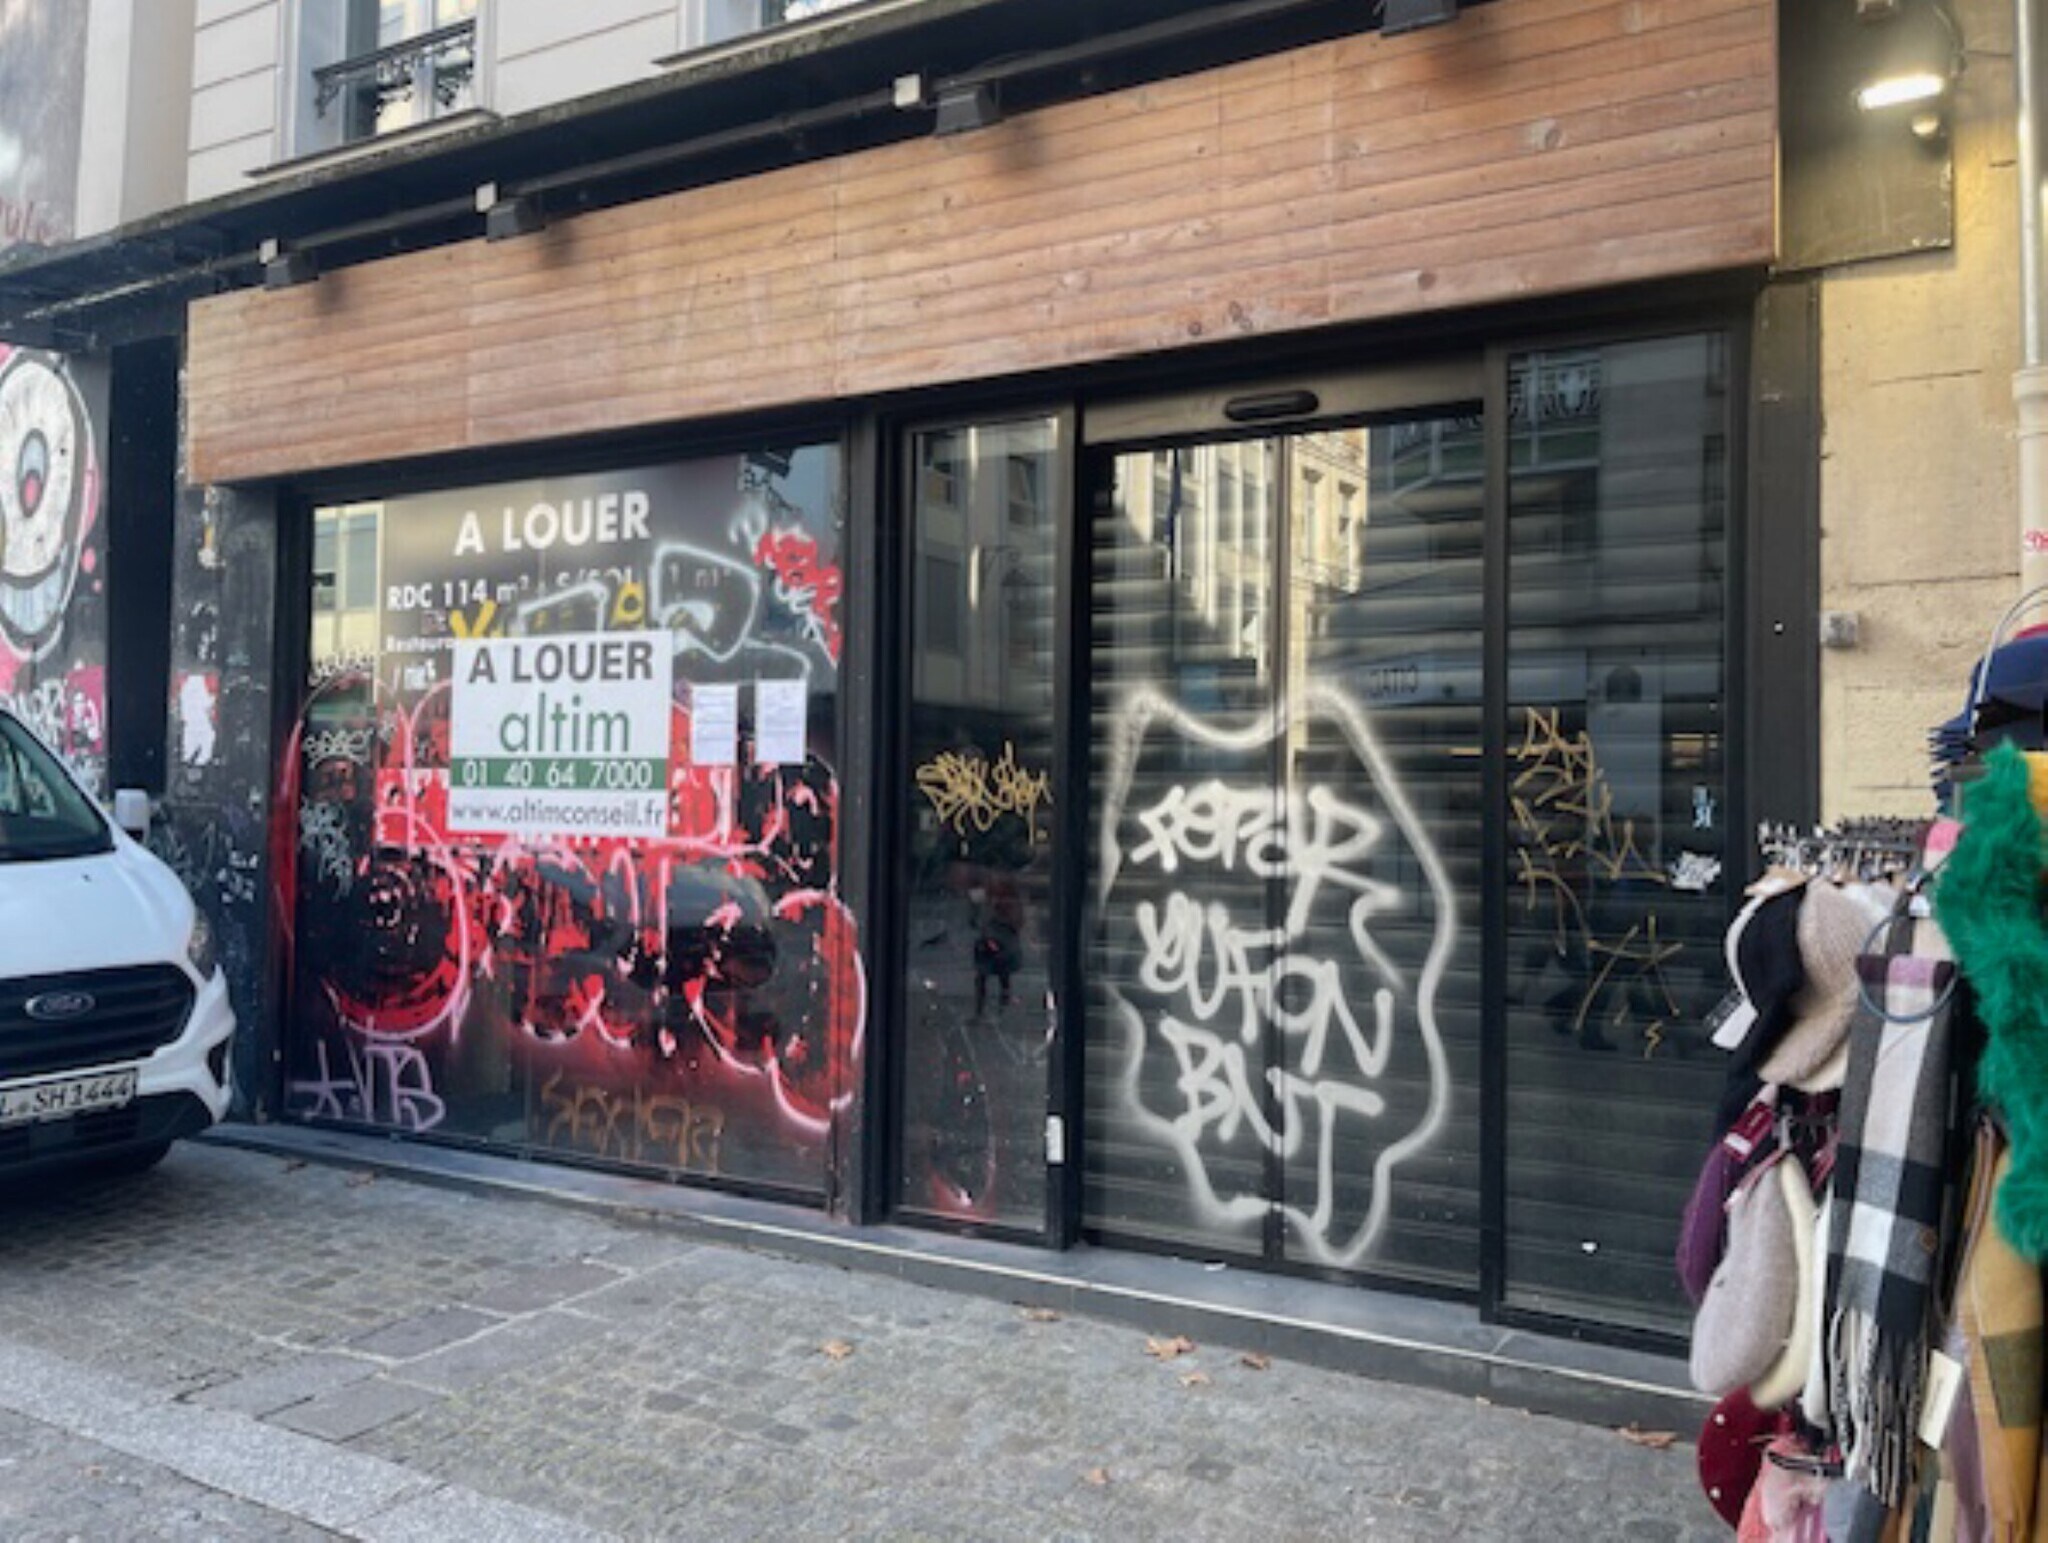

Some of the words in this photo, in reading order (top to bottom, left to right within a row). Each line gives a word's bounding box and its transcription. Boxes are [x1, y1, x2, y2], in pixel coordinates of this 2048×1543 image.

[454, 510, 486, 557] A
[502, 489, 651, 551] LOUER
[386, 582, 433, 612] RDC
[443, 578, 488, 609] 114
[467, 646, 497, 685] A
[511, 640, 654, 683] LOUER
[500, 691, 630, 752] altim
[462, 760, 488, 786] 01
[503, 761, 533, 786] 40
[545, 761, 576, 786] 64
[589, 761, 653, 787] 7000
[452, 798, 663, 826] www.altimconseil.fr
